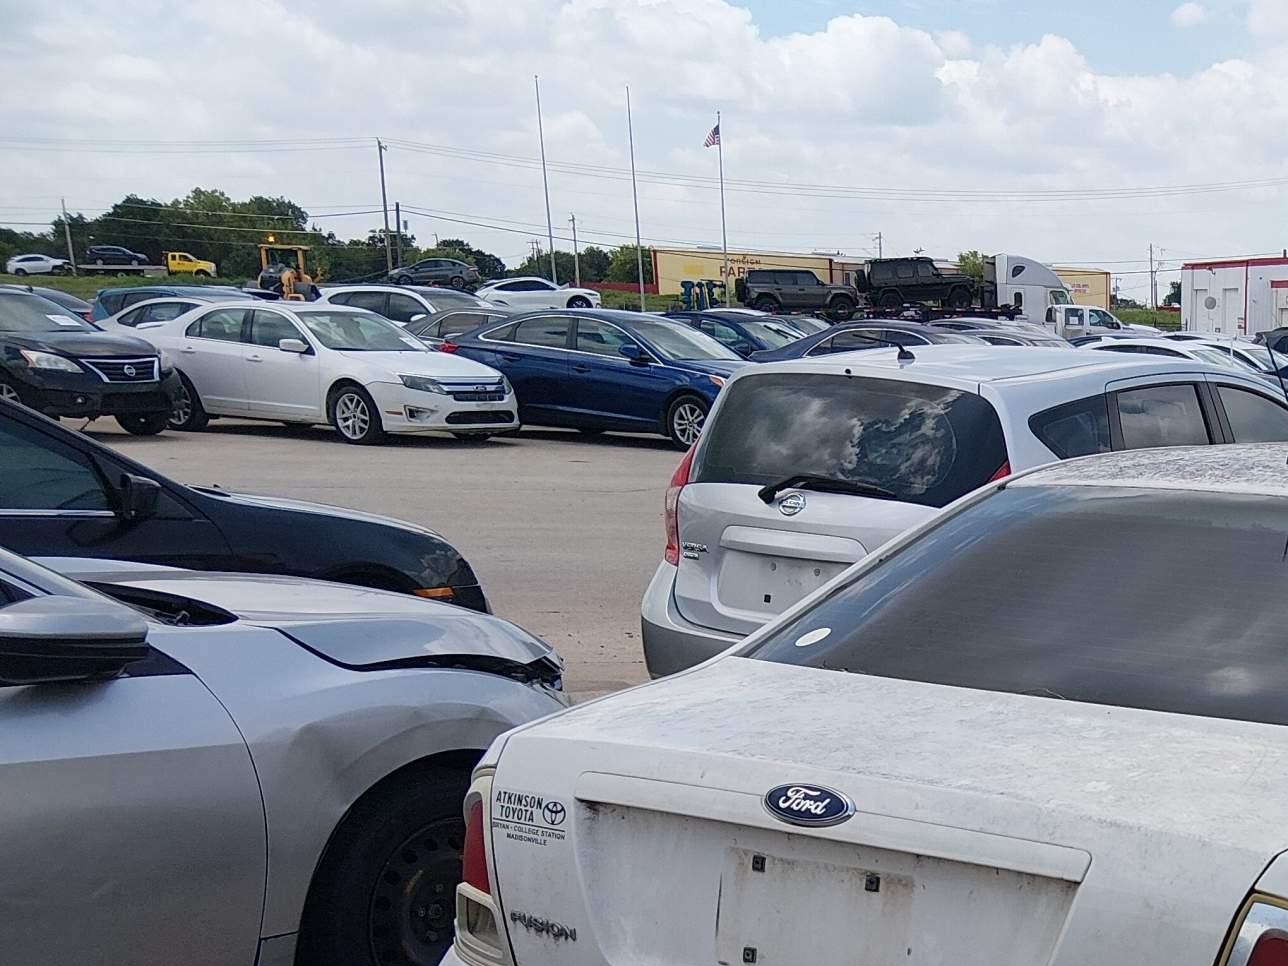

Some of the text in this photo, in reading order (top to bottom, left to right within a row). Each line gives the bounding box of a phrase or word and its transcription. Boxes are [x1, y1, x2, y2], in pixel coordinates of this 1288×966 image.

[496, 790, 543, 810] ATKINSON
[779, 787, 831, 815] Ford
[500, 805, 534, 823] TOYOTA
[506, 832, 548, 846] MADISONVILLE
[513, 825, 540, 836] COLLEGE
[541, 830, 566, 841] STATION
[510, 911, 577, 941] FUSION
